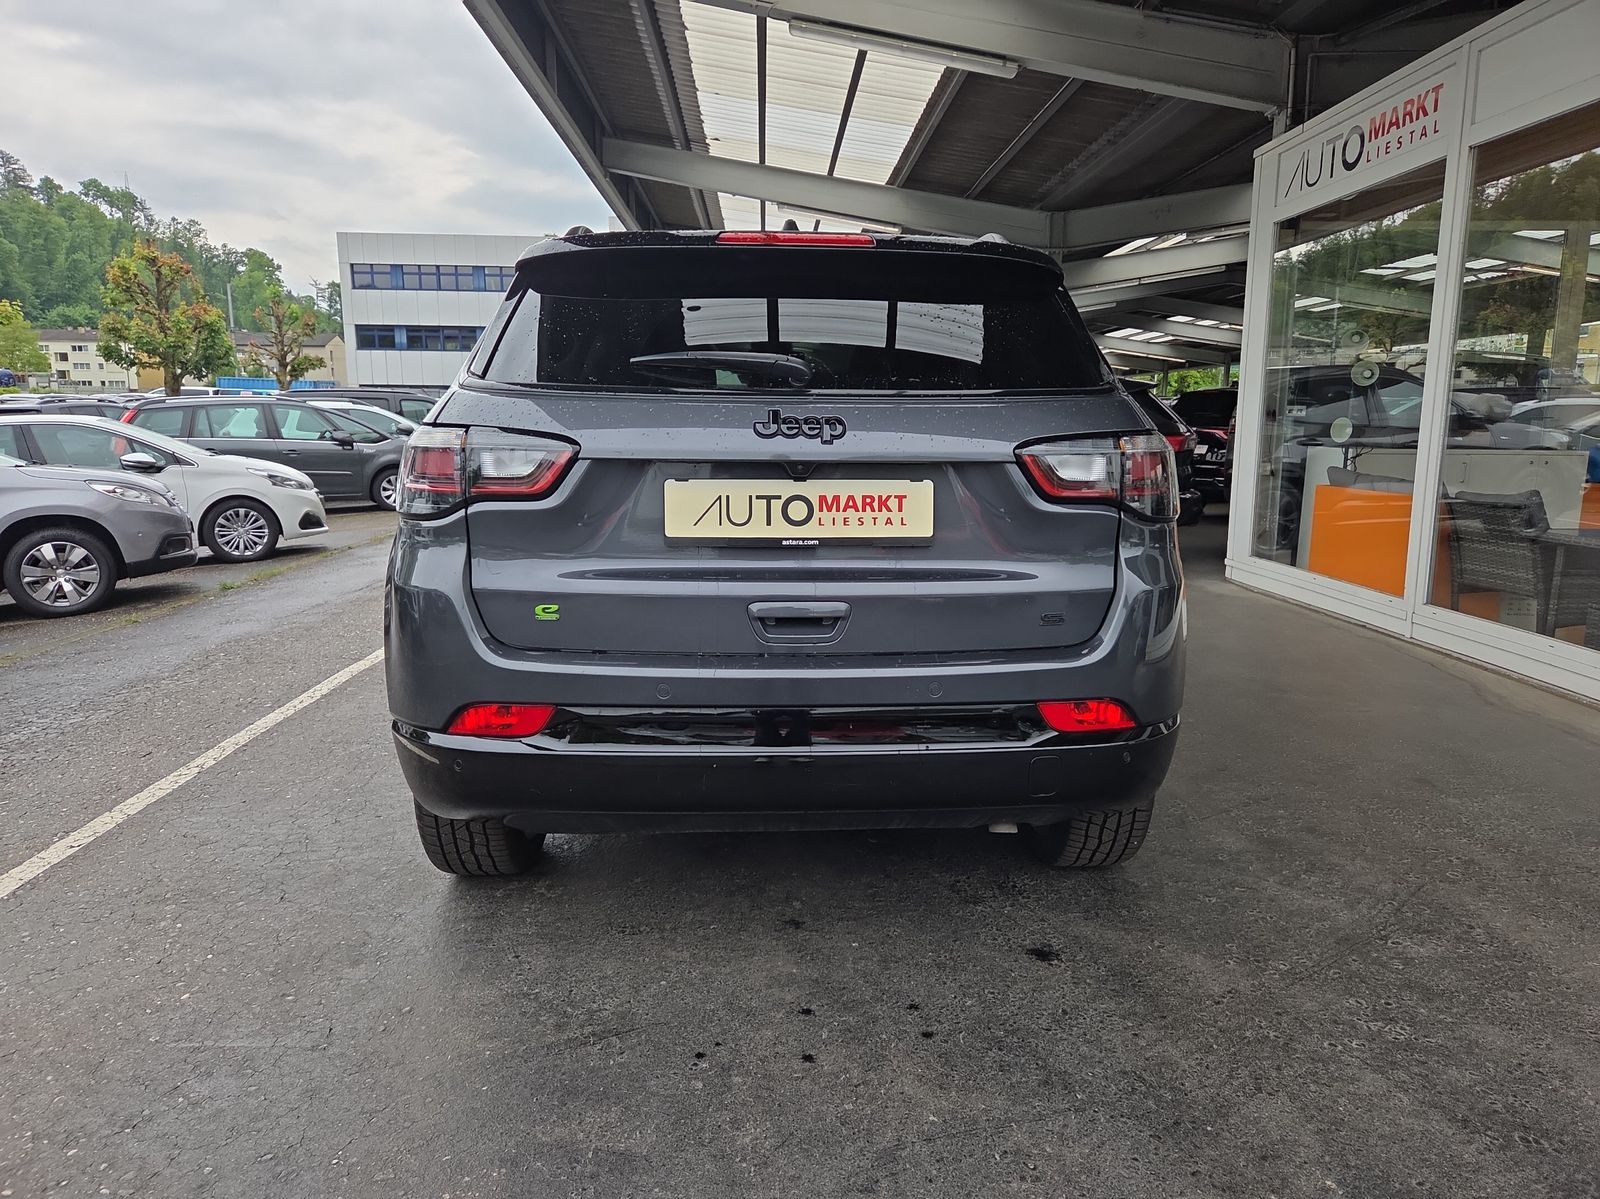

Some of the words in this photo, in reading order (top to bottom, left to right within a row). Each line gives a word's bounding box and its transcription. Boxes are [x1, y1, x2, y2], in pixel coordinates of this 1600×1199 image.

[1284, 124, 1366, 199] AUTO
[1367, 82, 1445, 143] MARKT
[1366, 119, 1440, 163] LIESTAL
[753, 408, 847, 445] Jeep
[692, 493, 815, 527] AUTO
[818, 494, 908, 513] MARKT
[818, 516, 908, 527] LIESTAL
[781, 538, 820, 546] astara.com
